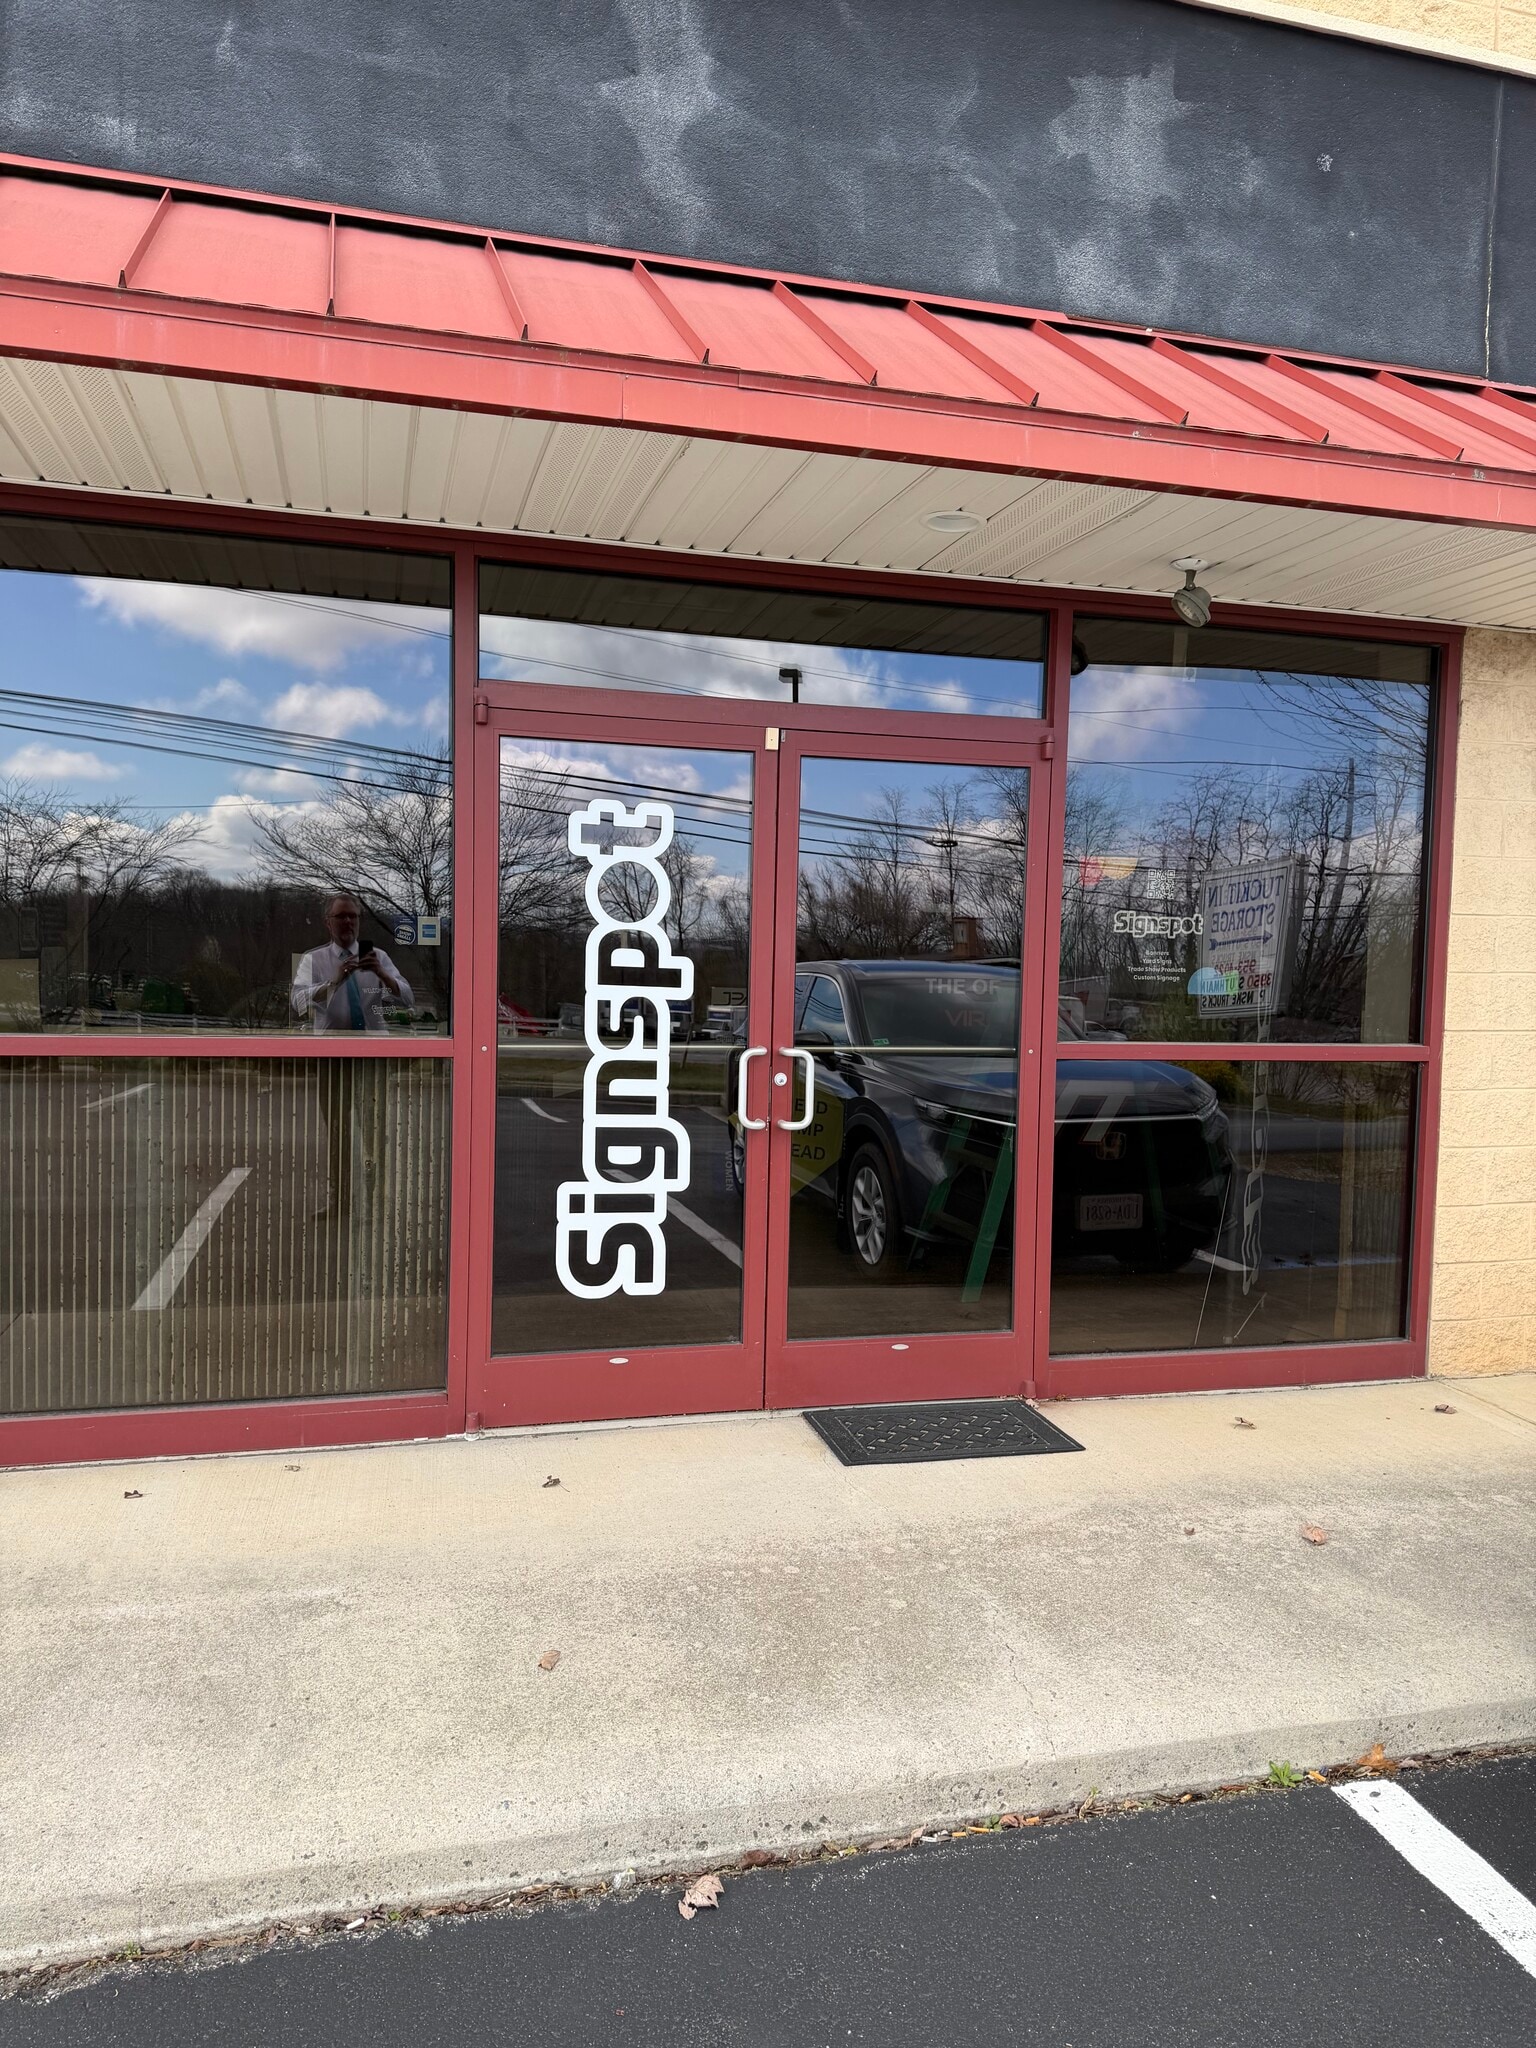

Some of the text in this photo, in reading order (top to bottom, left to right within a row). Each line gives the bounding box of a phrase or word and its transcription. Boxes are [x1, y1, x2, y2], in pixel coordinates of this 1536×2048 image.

[1113, 910, 1203, 938] Signspot
[925, 978, 966, 994] THE
[555, 798, 694, 1300] Signspot
[725, 1151, 734, 1192] WOMEN
